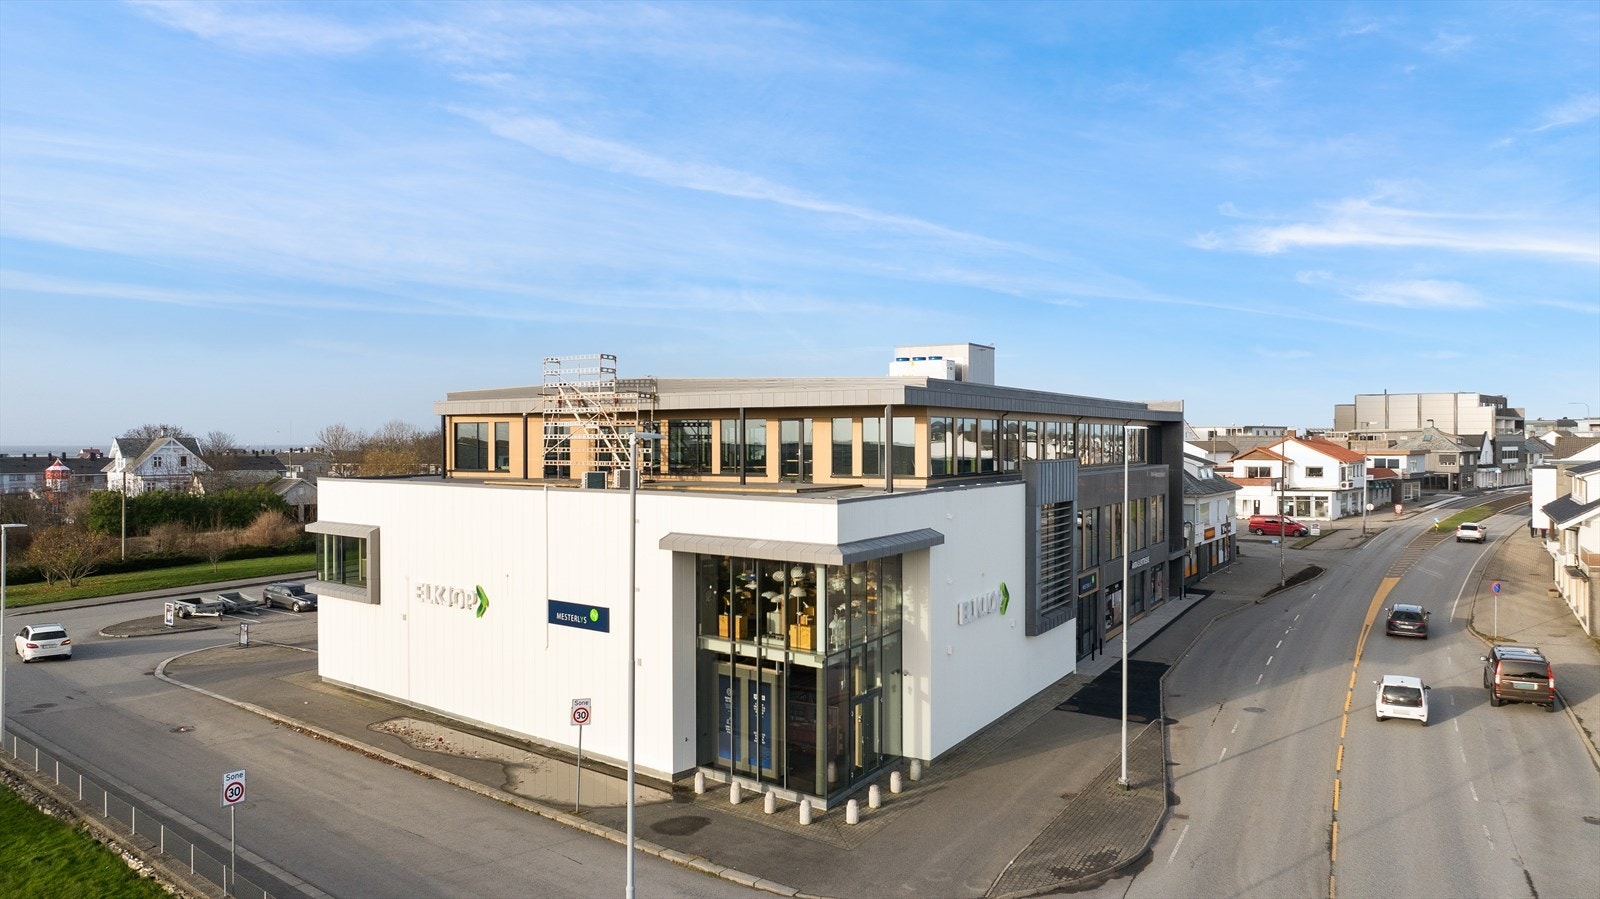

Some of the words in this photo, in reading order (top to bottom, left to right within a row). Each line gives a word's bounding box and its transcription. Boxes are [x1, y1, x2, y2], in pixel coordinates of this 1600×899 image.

[556, 612, 588, 624] MESTERLYS
[576, 711, 587, 720] 30
[225, 773, 244, 781] Sone
[228, 786, 241, 798] 30
